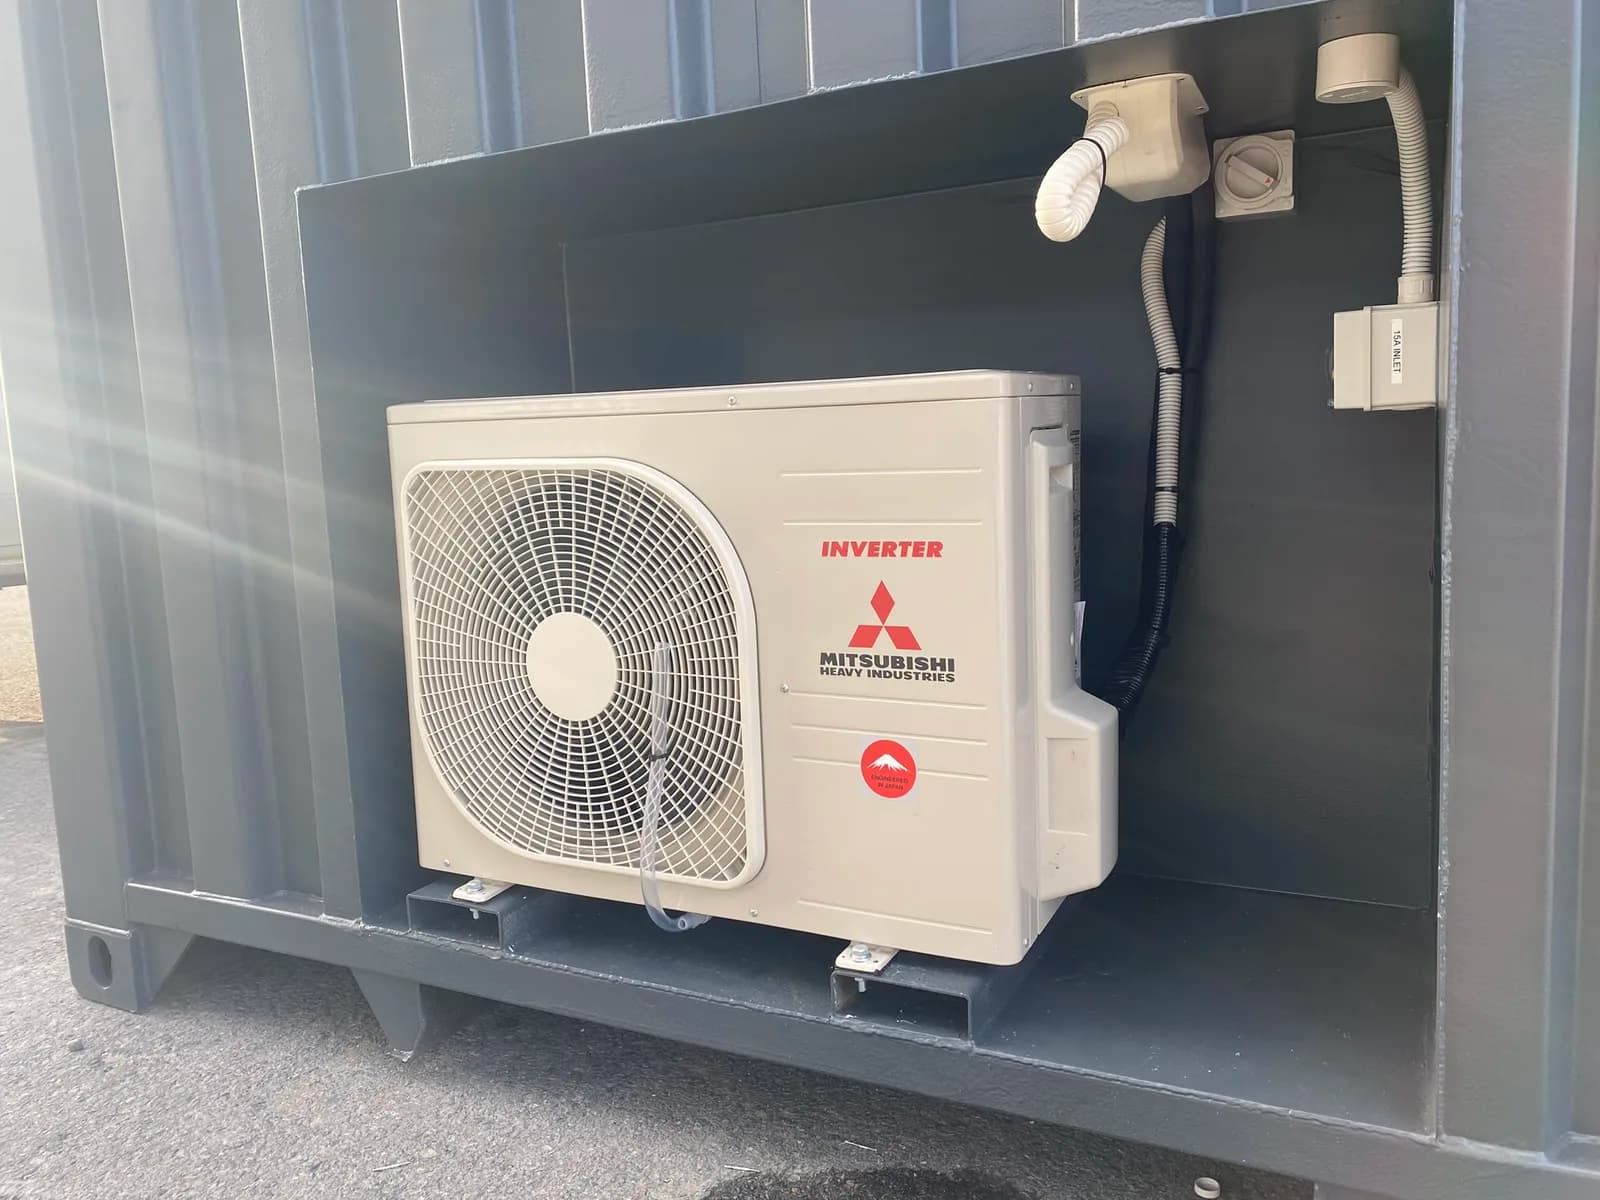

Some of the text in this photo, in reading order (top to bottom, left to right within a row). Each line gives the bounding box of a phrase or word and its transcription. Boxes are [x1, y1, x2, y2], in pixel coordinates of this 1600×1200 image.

[1393, 330, 1401, 373] 15A INLET
[821, 541, 944, 558] INVERTER
[819, 652, 955, 672] MITSUBISHI
[820, 667, 955, 682] HEAVY INDUSTRIES
